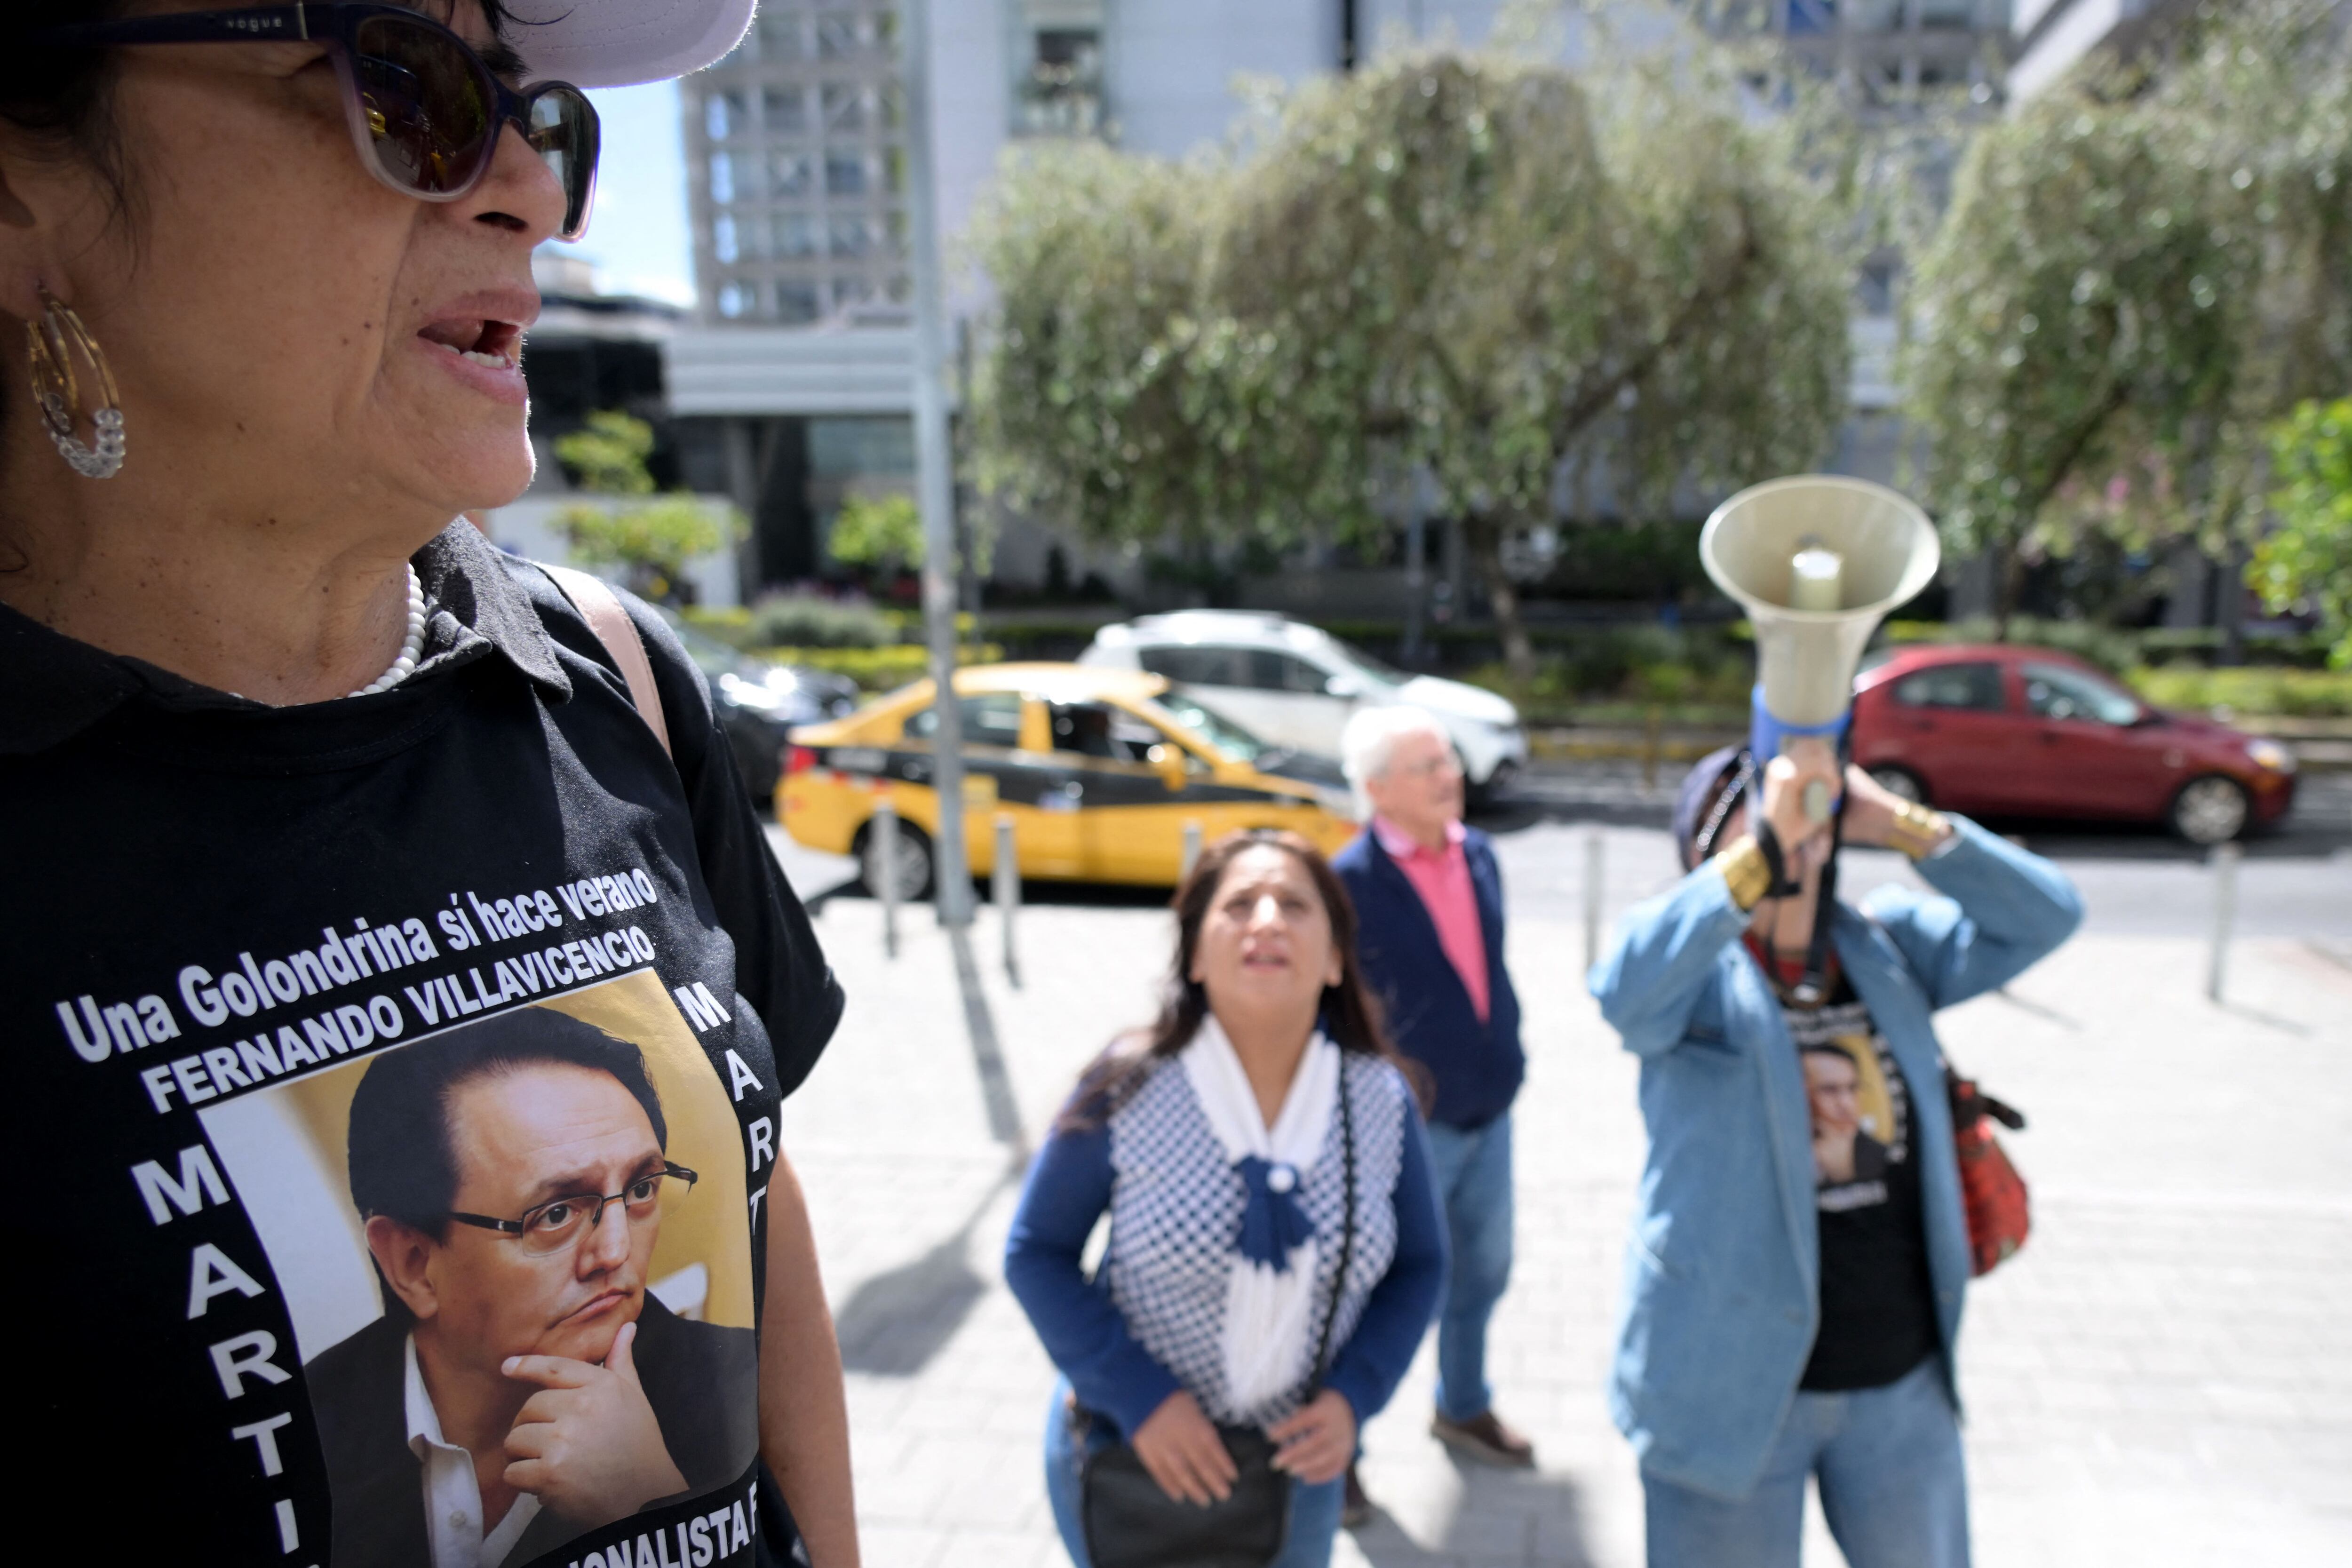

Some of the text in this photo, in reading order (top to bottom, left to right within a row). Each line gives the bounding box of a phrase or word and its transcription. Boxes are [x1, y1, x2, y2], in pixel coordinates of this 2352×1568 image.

[56, 868, 658, 1063] Una Golondrina sí hace verano
[141, 925, 656, 1114] FERNANDO VILLAVICENCIO
[130, 1143, 320, 1568] MARTI
